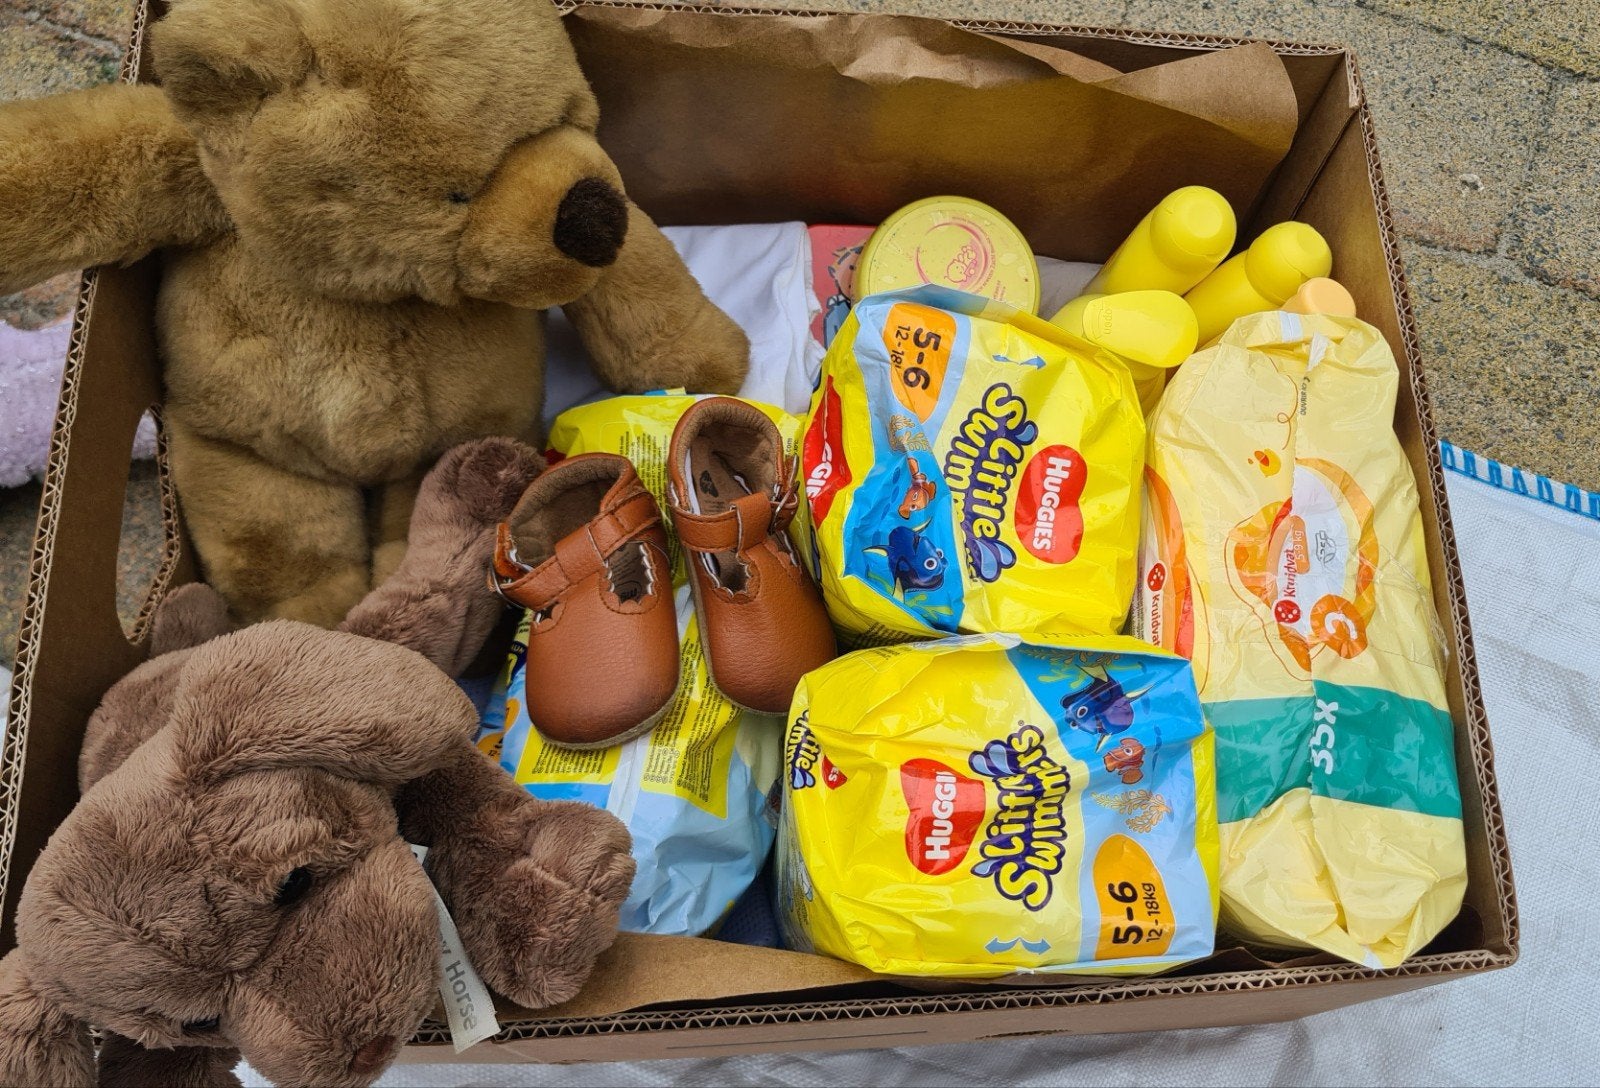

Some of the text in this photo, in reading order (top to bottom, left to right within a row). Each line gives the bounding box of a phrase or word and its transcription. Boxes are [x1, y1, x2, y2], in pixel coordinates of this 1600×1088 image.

[890, 324, 912, 371] 12-18
[901, 327, 943, 391] 5-6
[972, 437, 1022, 539] Little
[1031, 456, 1071, 551] HUGGIES
[1293, 530, 1303, 542] kg
[1283, 549, 1297, 598] Kruidvat
[1151, 594, 1161, 647] Kruidvat
[924, 771, 956, 860] HUGGI
[1107, 880, 1144, 945] 5-6
[444, 960, 477, 1031] Horse
